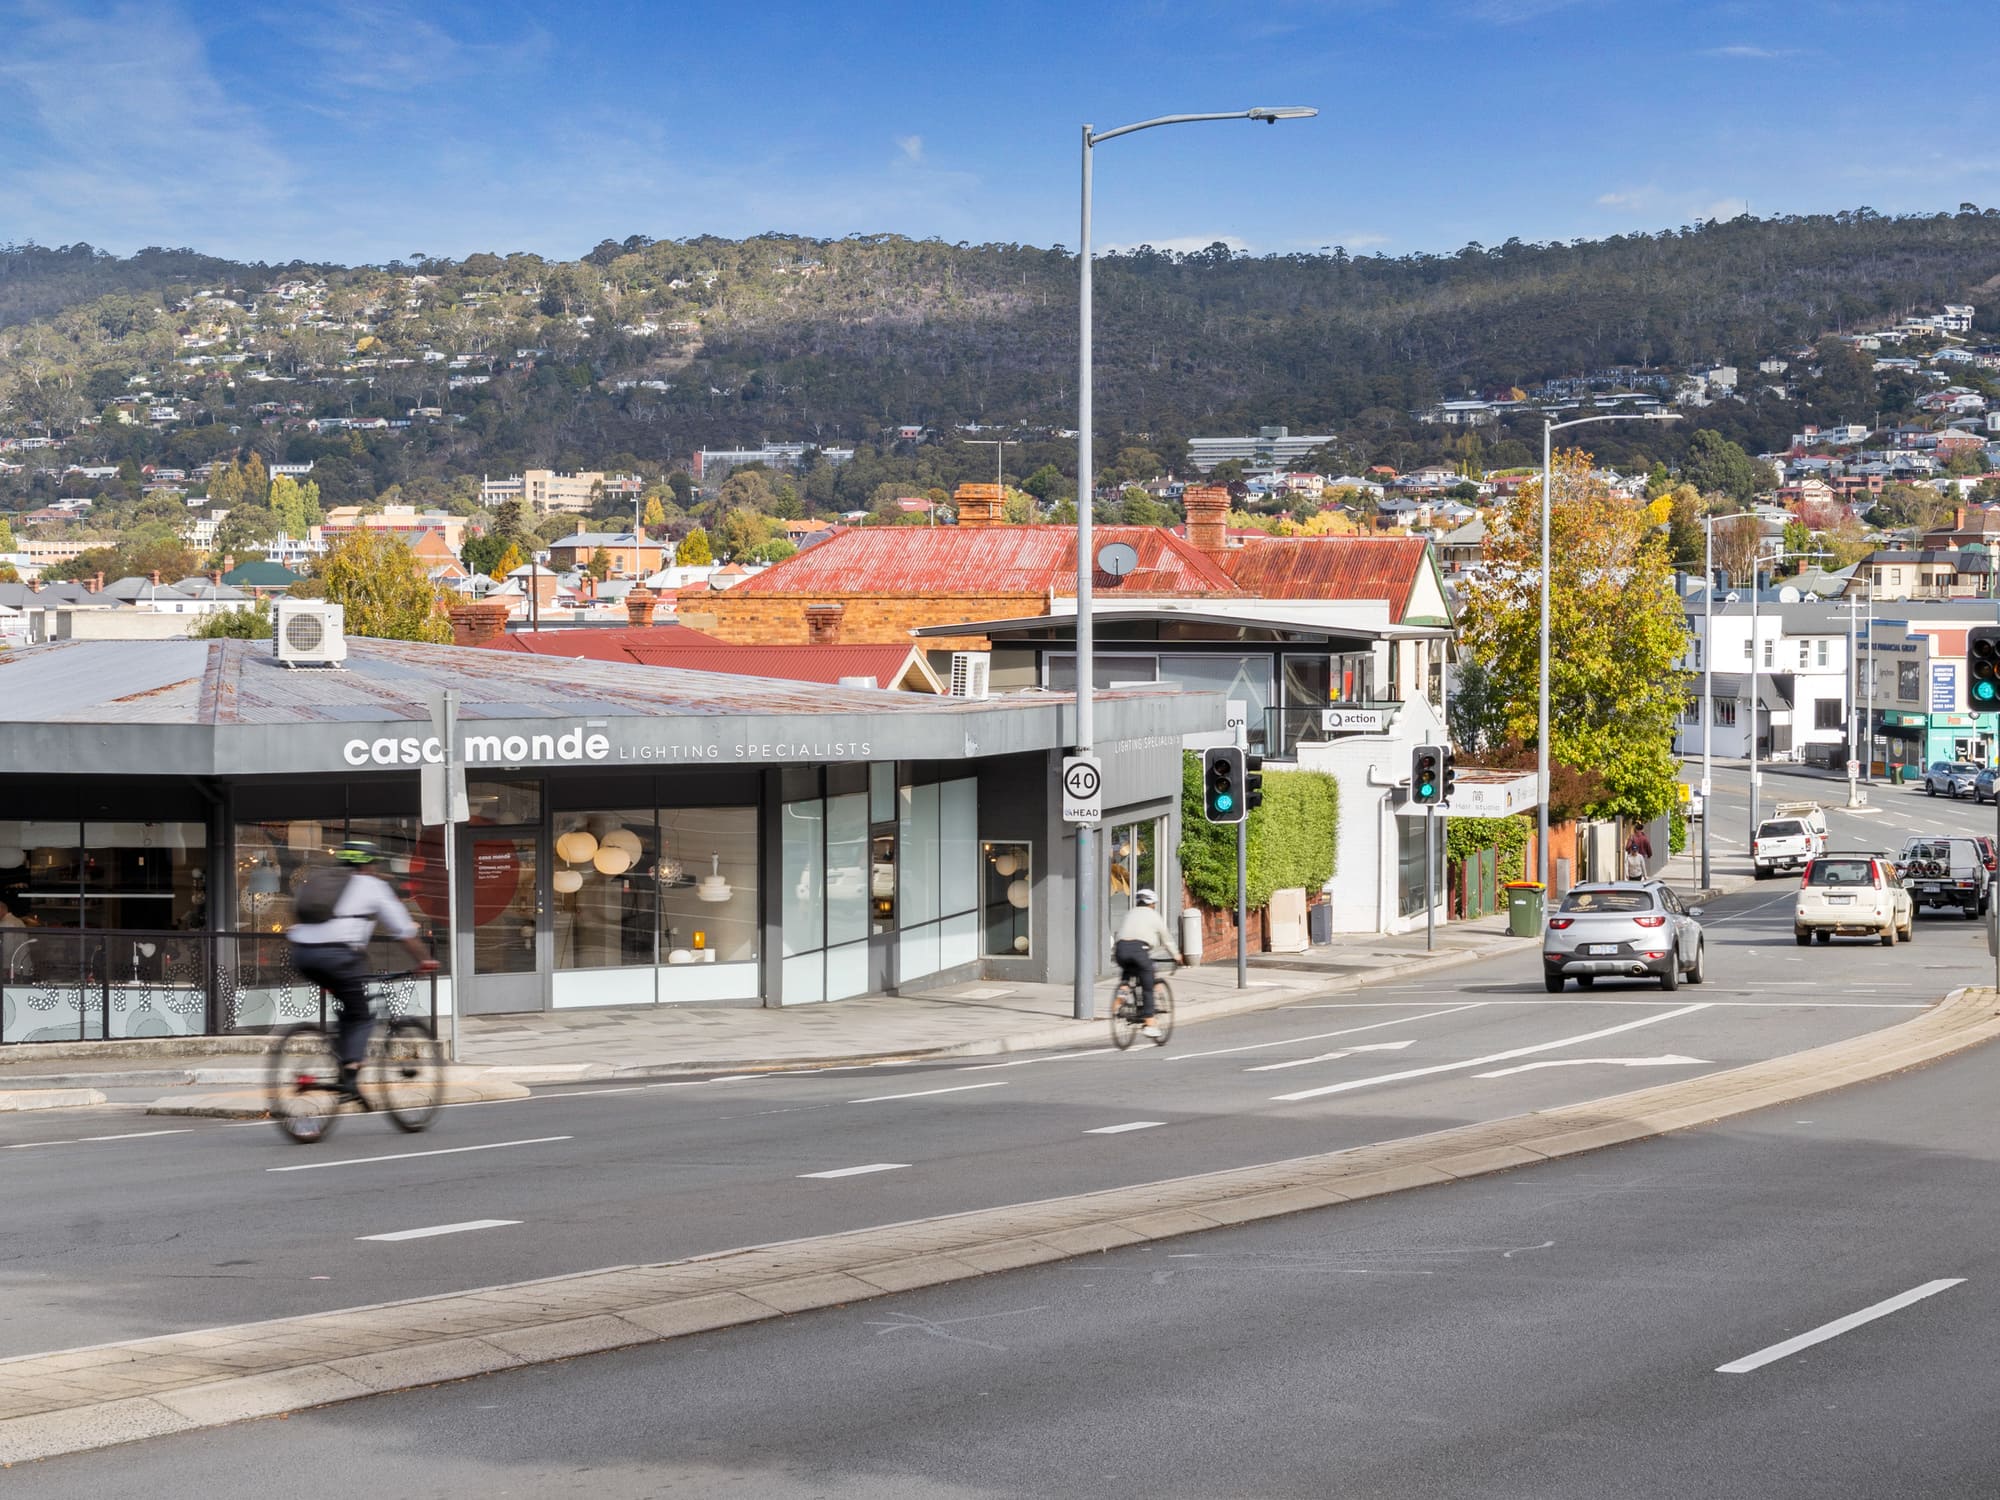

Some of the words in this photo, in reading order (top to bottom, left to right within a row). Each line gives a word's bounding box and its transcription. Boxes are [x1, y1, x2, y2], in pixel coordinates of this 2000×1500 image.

[1344, 713, 1376, 723] action
[619, 744, 719, 759] LIGHTING
[734, 742, 872, 758] SPECIALISTS
[1114, 737, 1142, 754] LIGHTING
[1143, 735, 1180, 749] SPECIALISTS
[1069, 772, 1095, 789] 40
[1065, 808, 1099, 817] AHEAD
[27, 946, 257, 1030] sandy
[279, 947, 417, 1036] by
